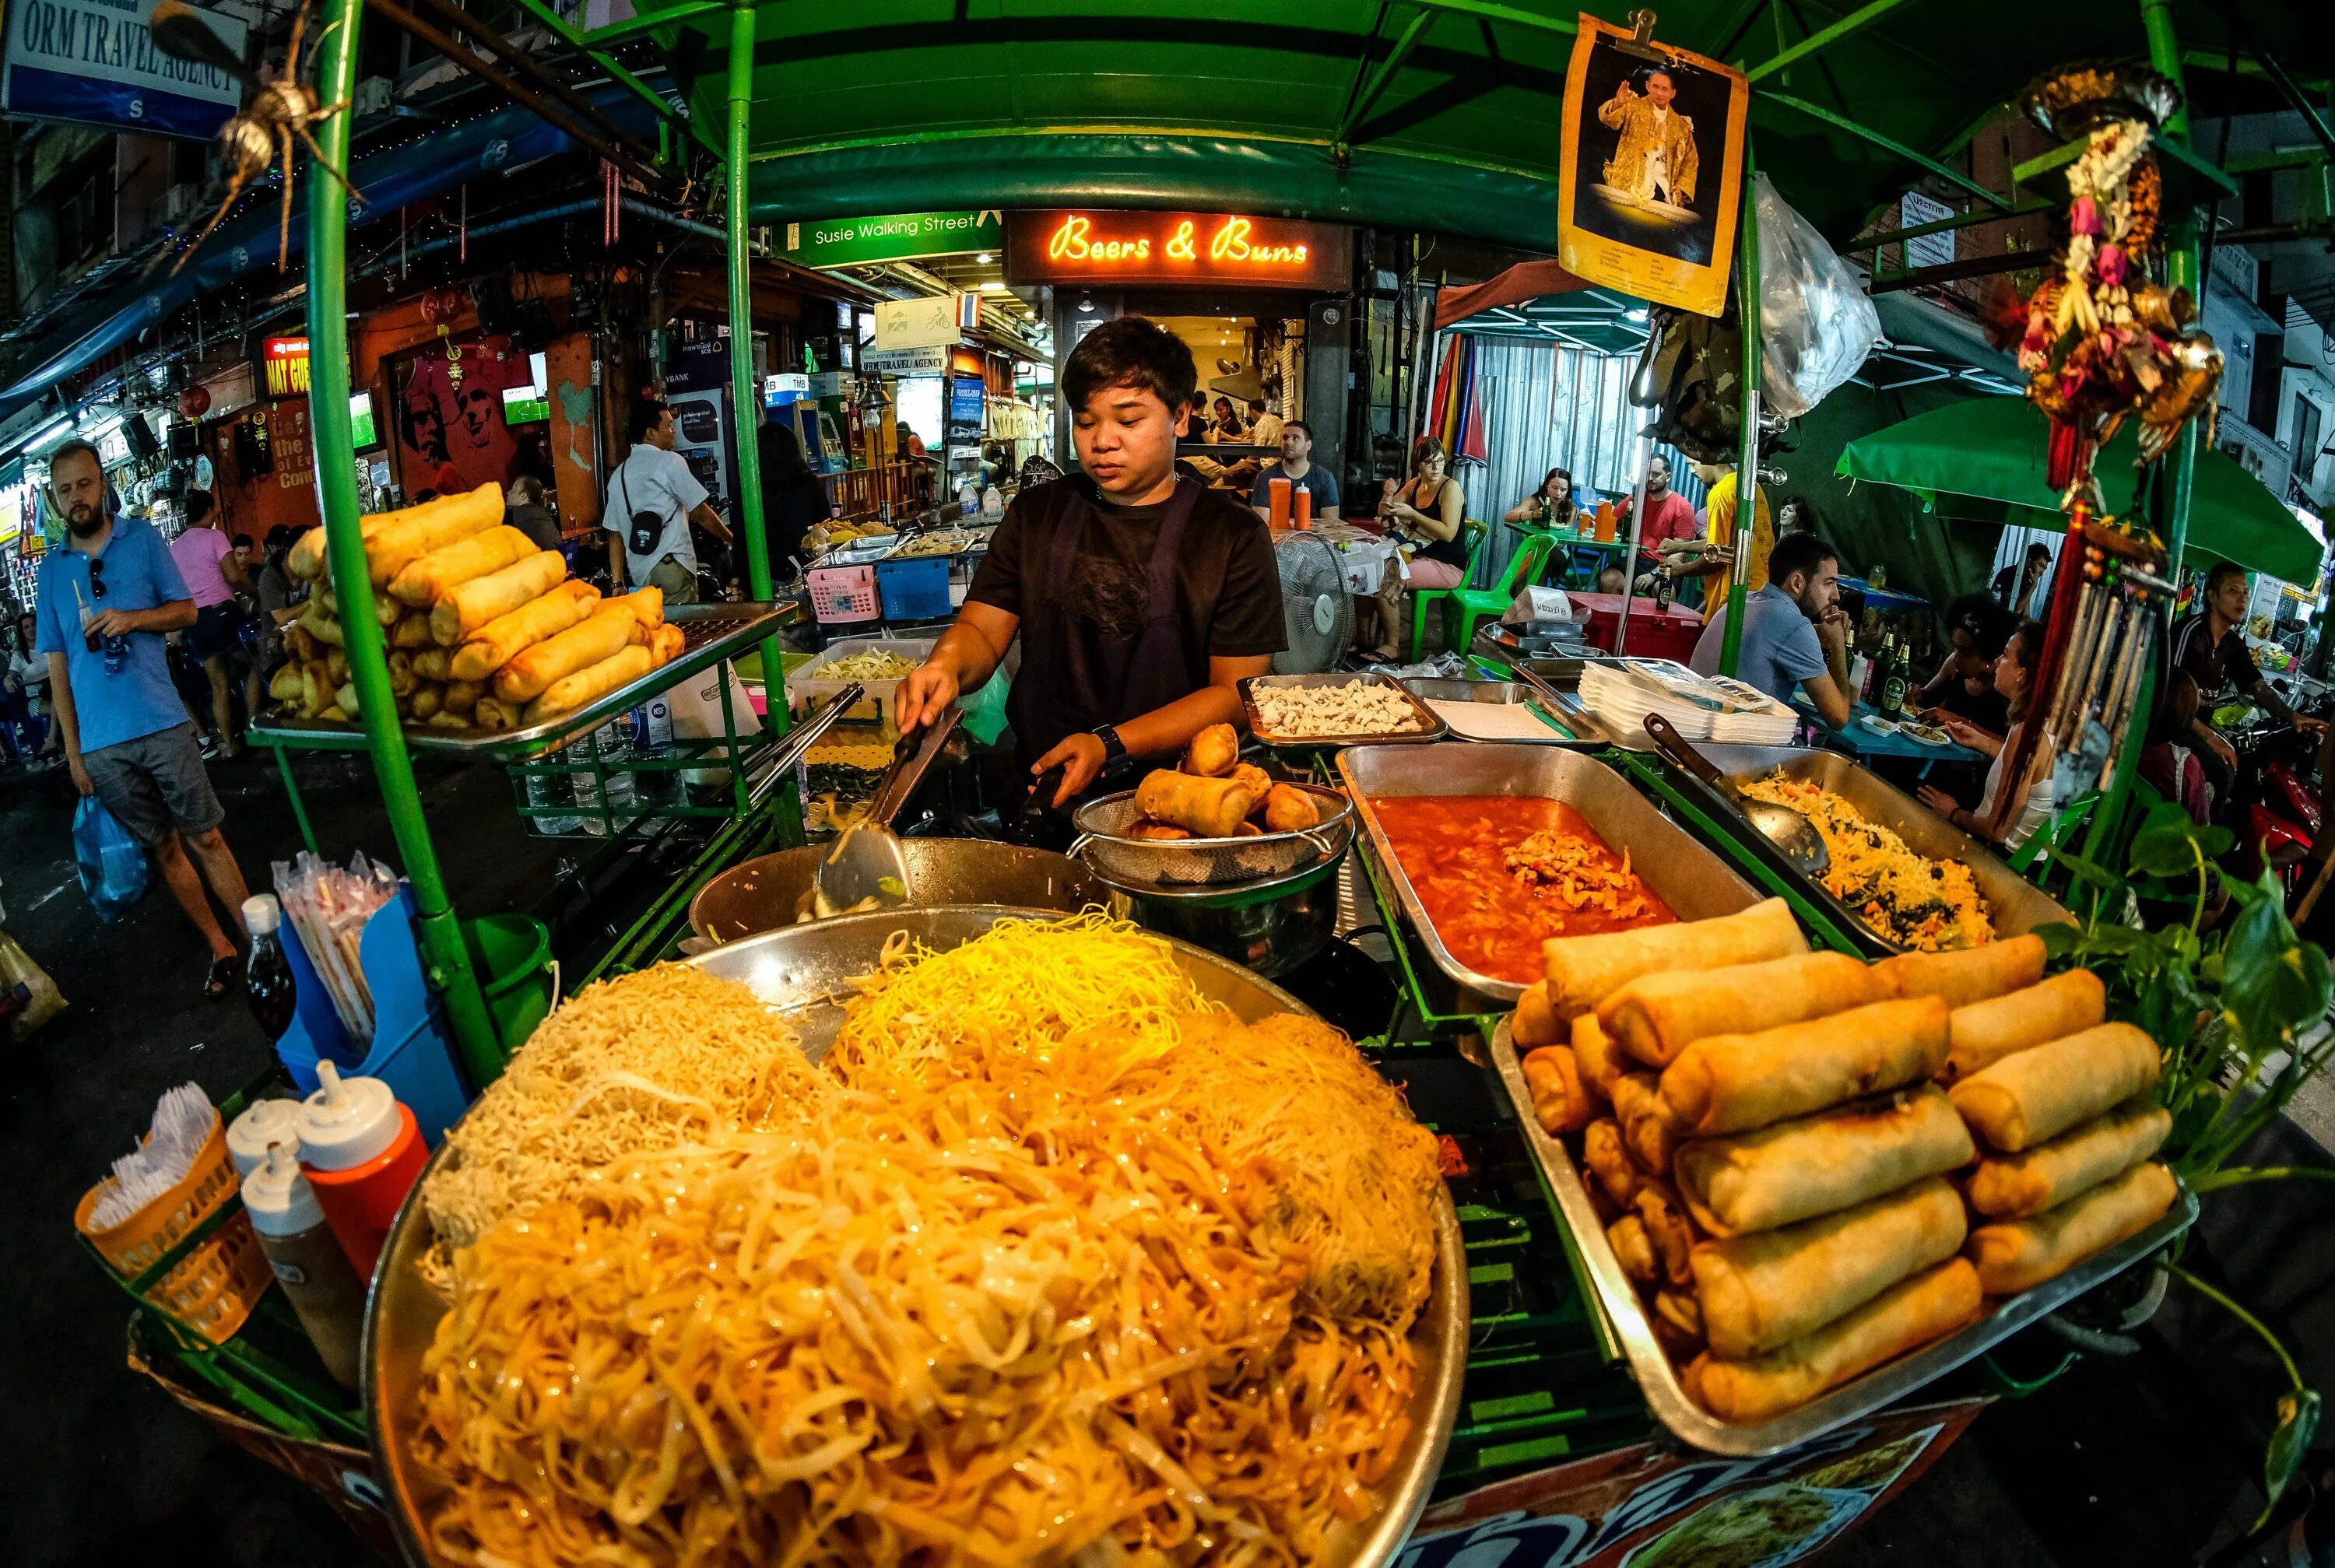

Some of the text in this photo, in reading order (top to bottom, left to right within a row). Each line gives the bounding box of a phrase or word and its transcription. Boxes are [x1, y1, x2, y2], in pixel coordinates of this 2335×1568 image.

[23, 1, 77, 58] ORM
[83, 12, 156, 73] TRAVEL
[1912, 195, 1944, 216] ประกาศ
[816, 214, 974, 244] Susie Walking Street
[1049, 215, 1308, 263] Beers & Buns
[913, 357, 943, 368] AGENCY
[266, 359, 287, 395] NAT
[792, 379, 806, 389] TMB
[275, 439, 303, 458] the
[654, 706, 665, 715] NSF
